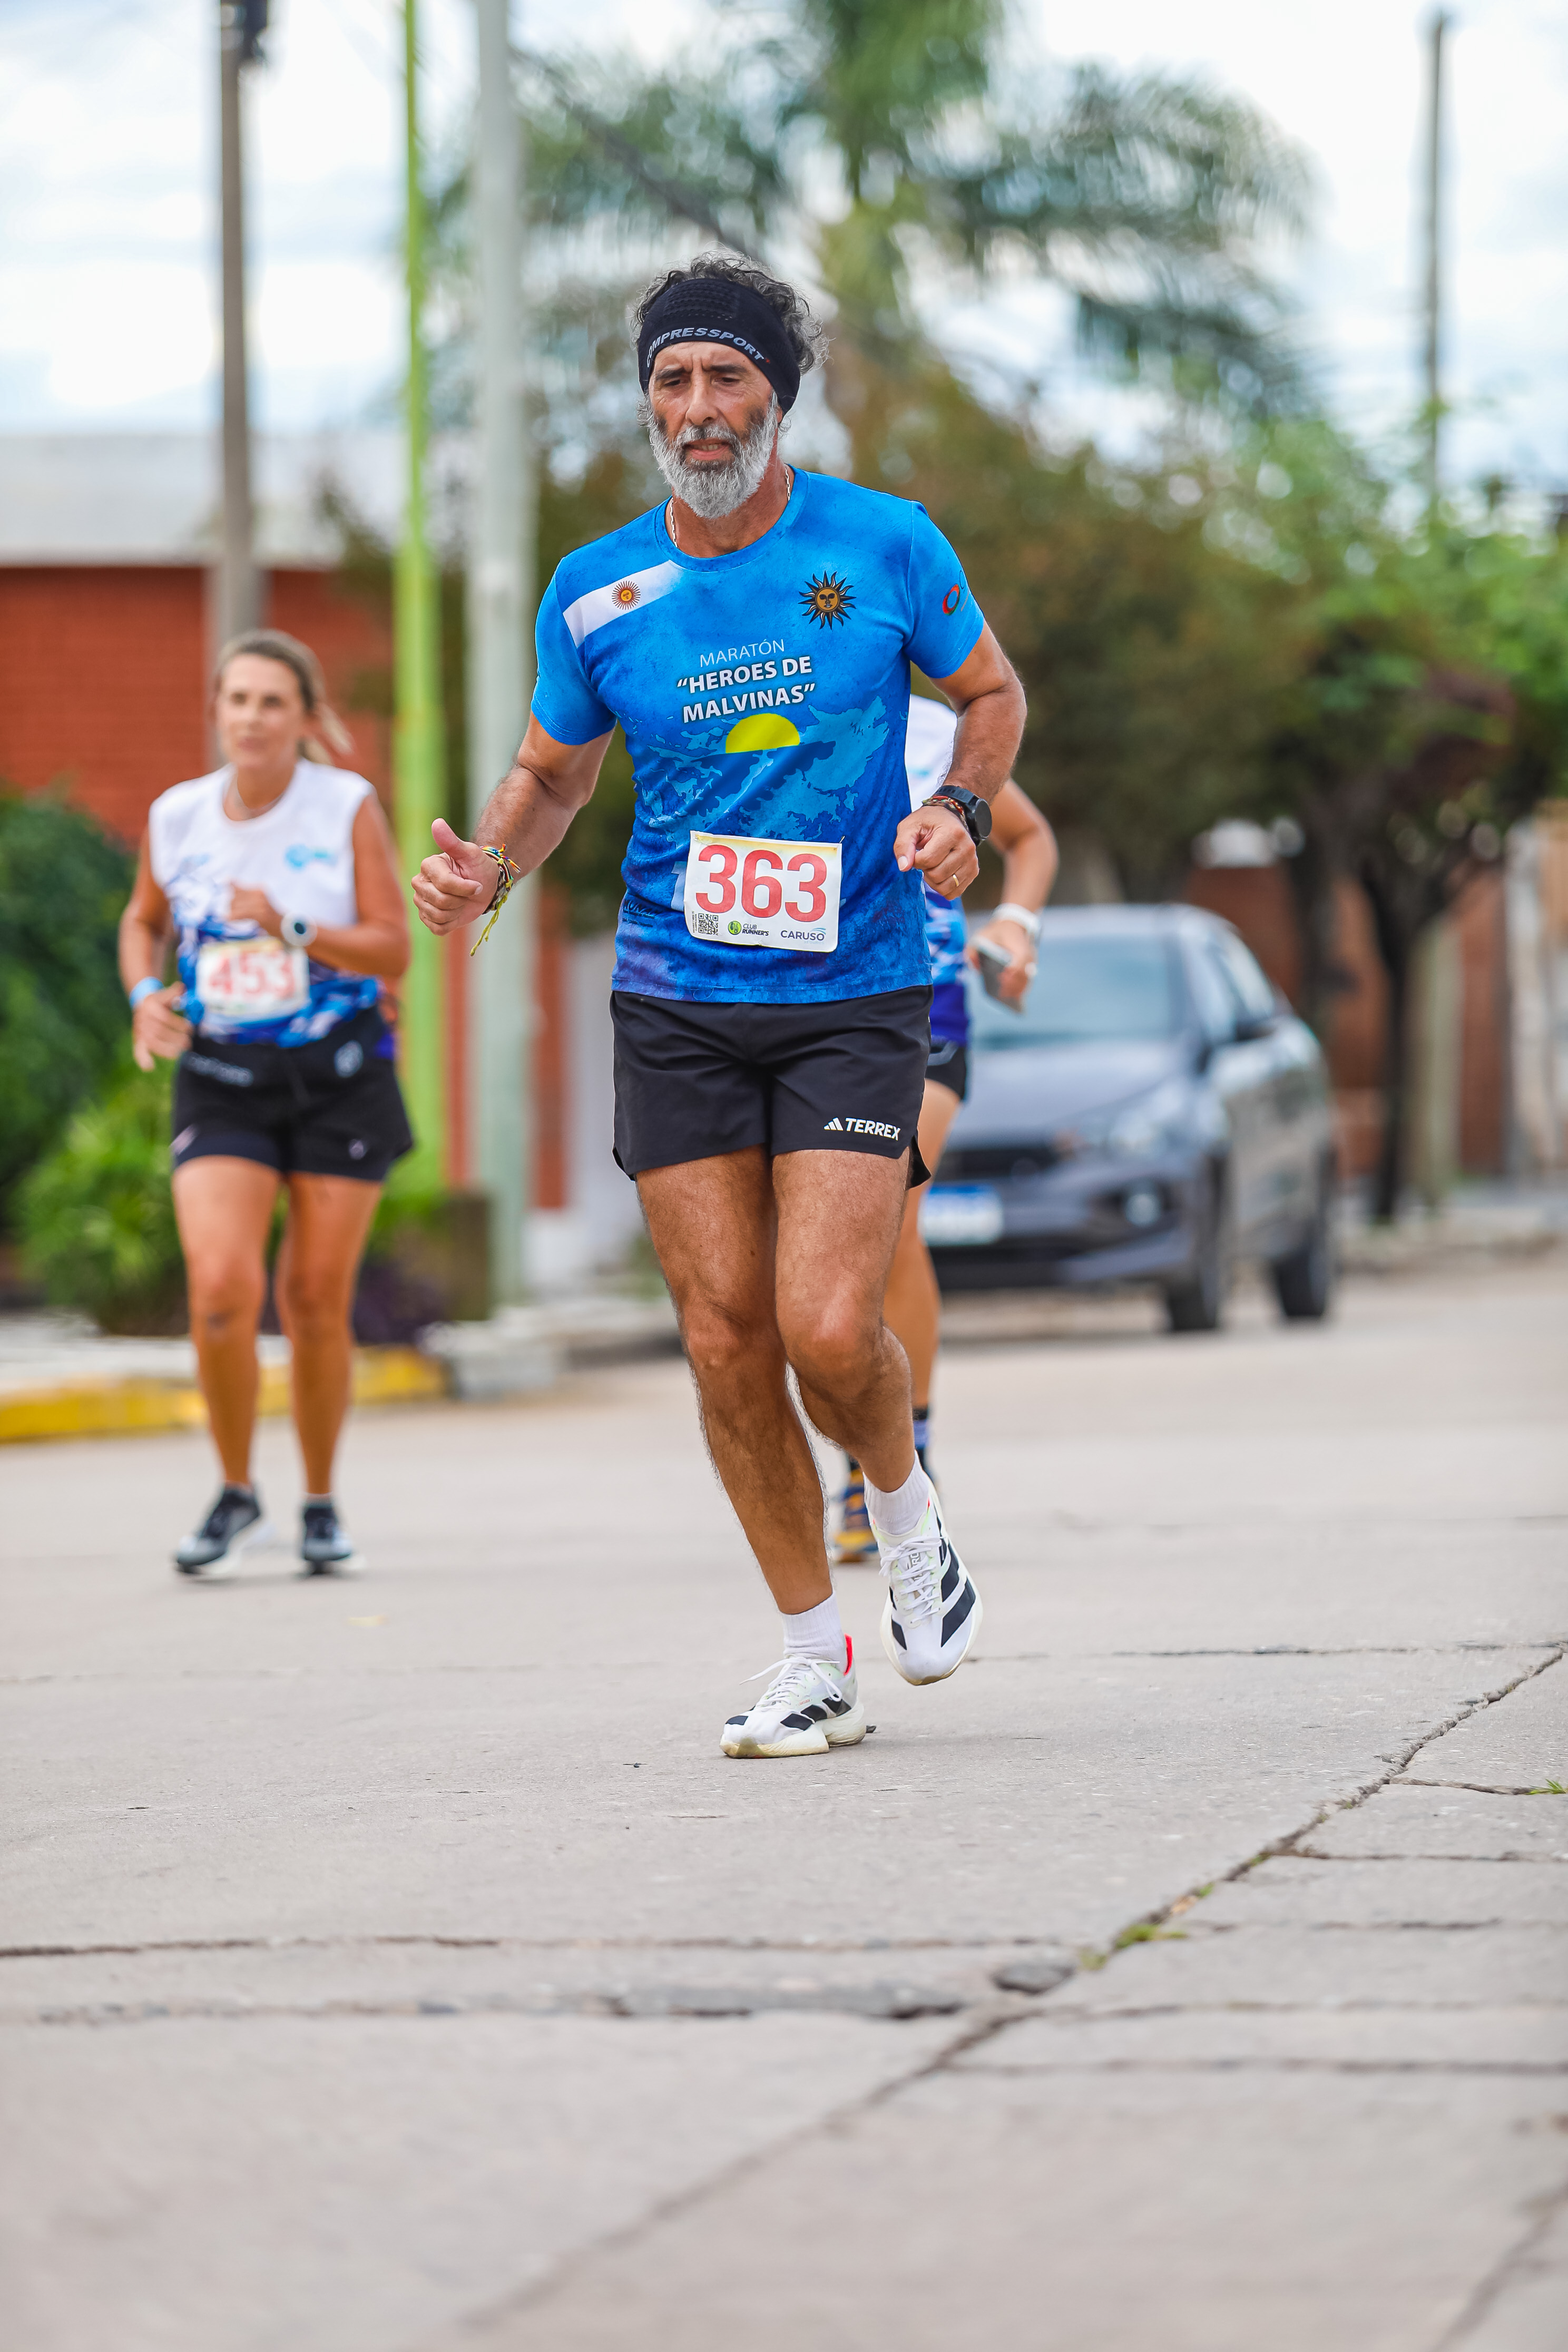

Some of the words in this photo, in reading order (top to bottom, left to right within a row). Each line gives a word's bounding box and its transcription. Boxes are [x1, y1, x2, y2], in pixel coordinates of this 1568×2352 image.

[646, 327, 765, 368] COMPRESSPORT
[700, 639, 785, 668] MARATÓN
[782, 656, 812, 677] DE
[695, 844, 827, 923] 363
[780, 930, 825, 941] CARUSO
[209, 947, 296, 1001] 453
[845, 1117, 901, 1141] TERREX
